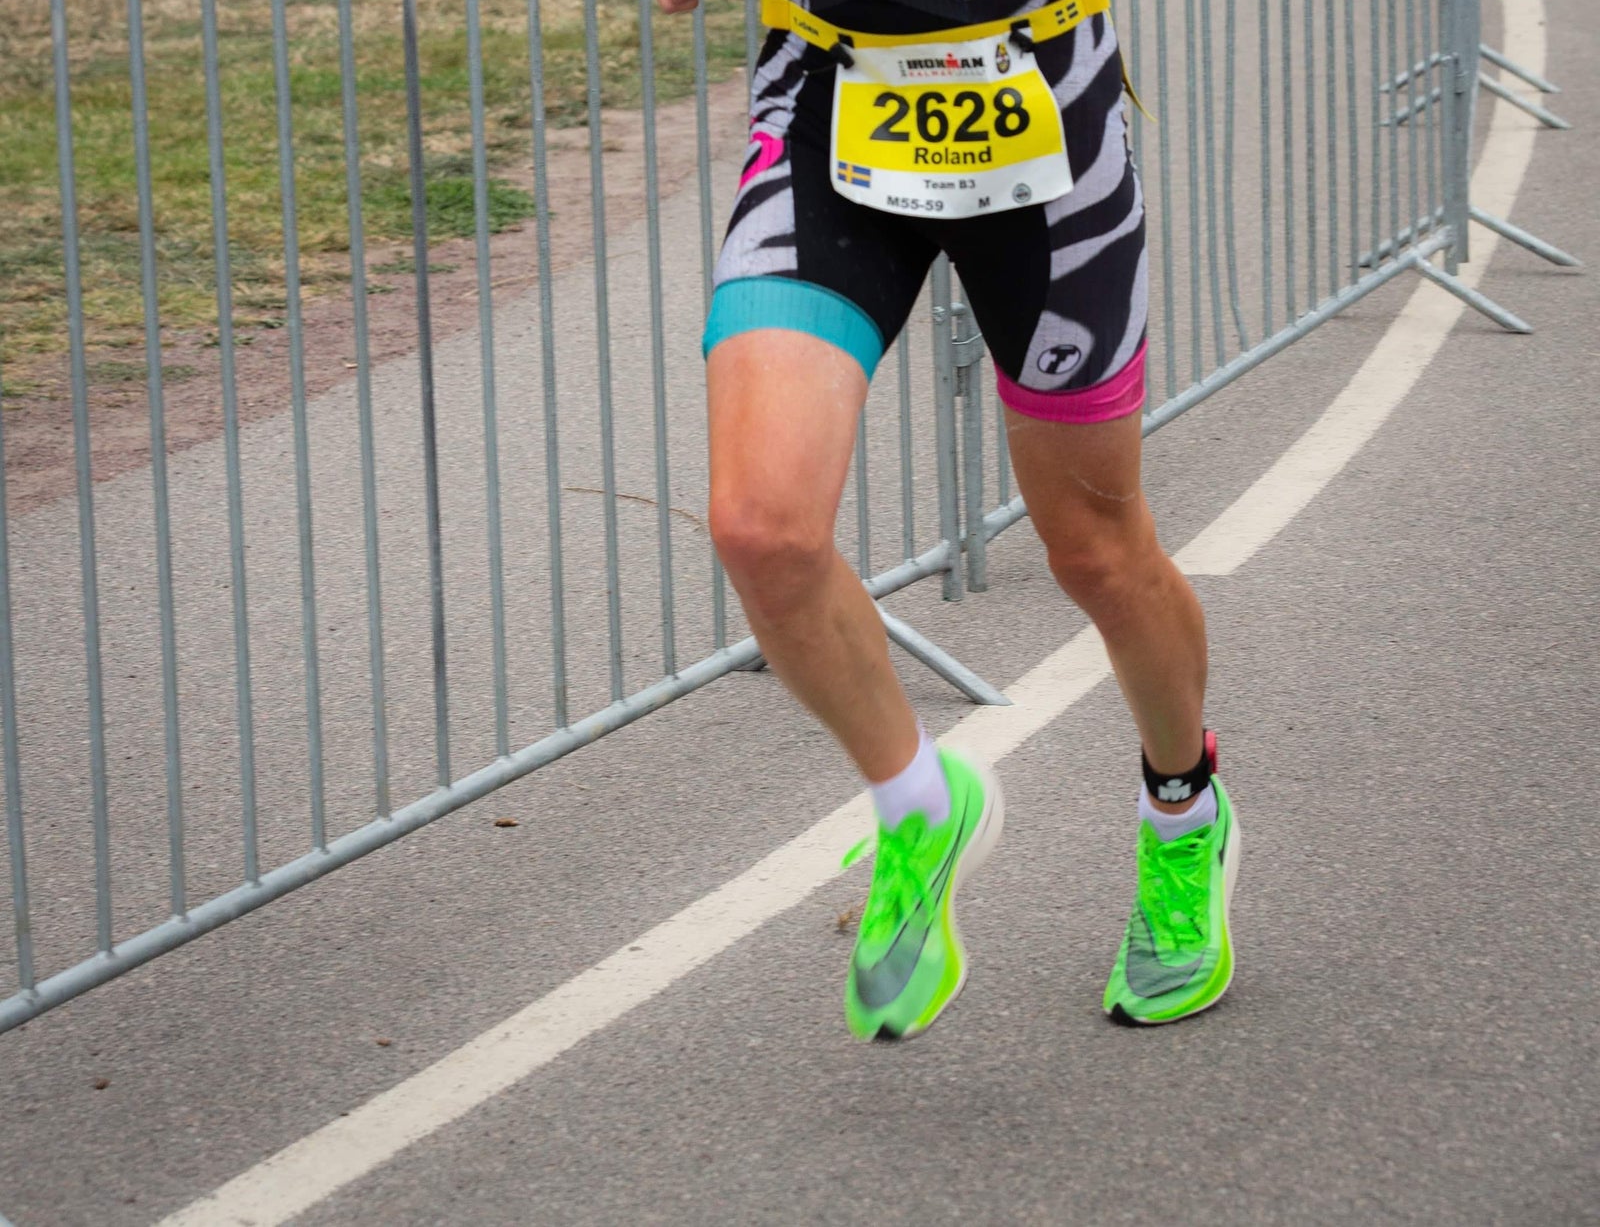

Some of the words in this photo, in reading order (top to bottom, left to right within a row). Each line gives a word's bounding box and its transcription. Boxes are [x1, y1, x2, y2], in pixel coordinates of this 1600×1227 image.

[906, 53, 984, 69] IRONMAN
[869, 87, 1030, 143] 2628
[913, 146, 992, 165] Roland
[924, 179, 955, 190] Team
[958, 179, 976, 189] B3
[886, 195, 944, 212] M55-59
[978, 196, 990, 209] M
